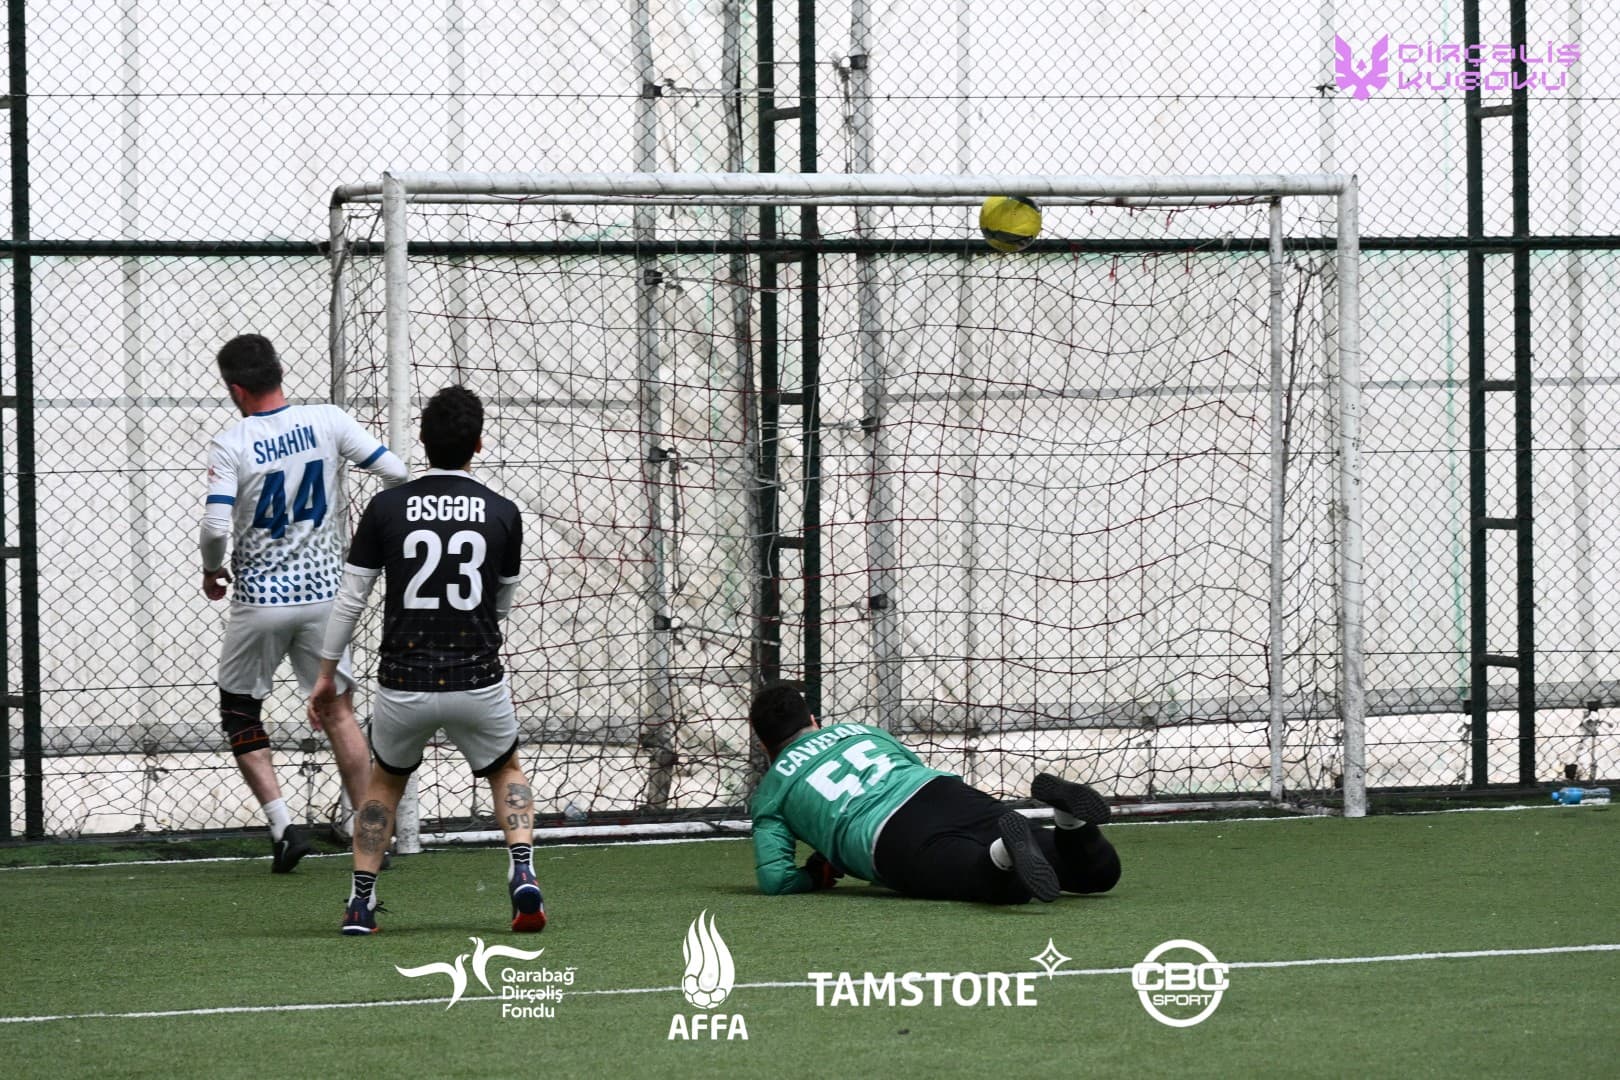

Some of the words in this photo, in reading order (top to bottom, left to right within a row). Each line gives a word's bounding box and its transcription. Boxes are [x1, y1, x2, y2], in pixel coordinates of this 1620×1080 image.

[253, 424, 317, 465] SHAHİN
[252, 459, 328, 540] 44
[403, 529, 487, 611] 23
[805, 739, 897, 802] 55
[506, 813, 530, 831] 99
